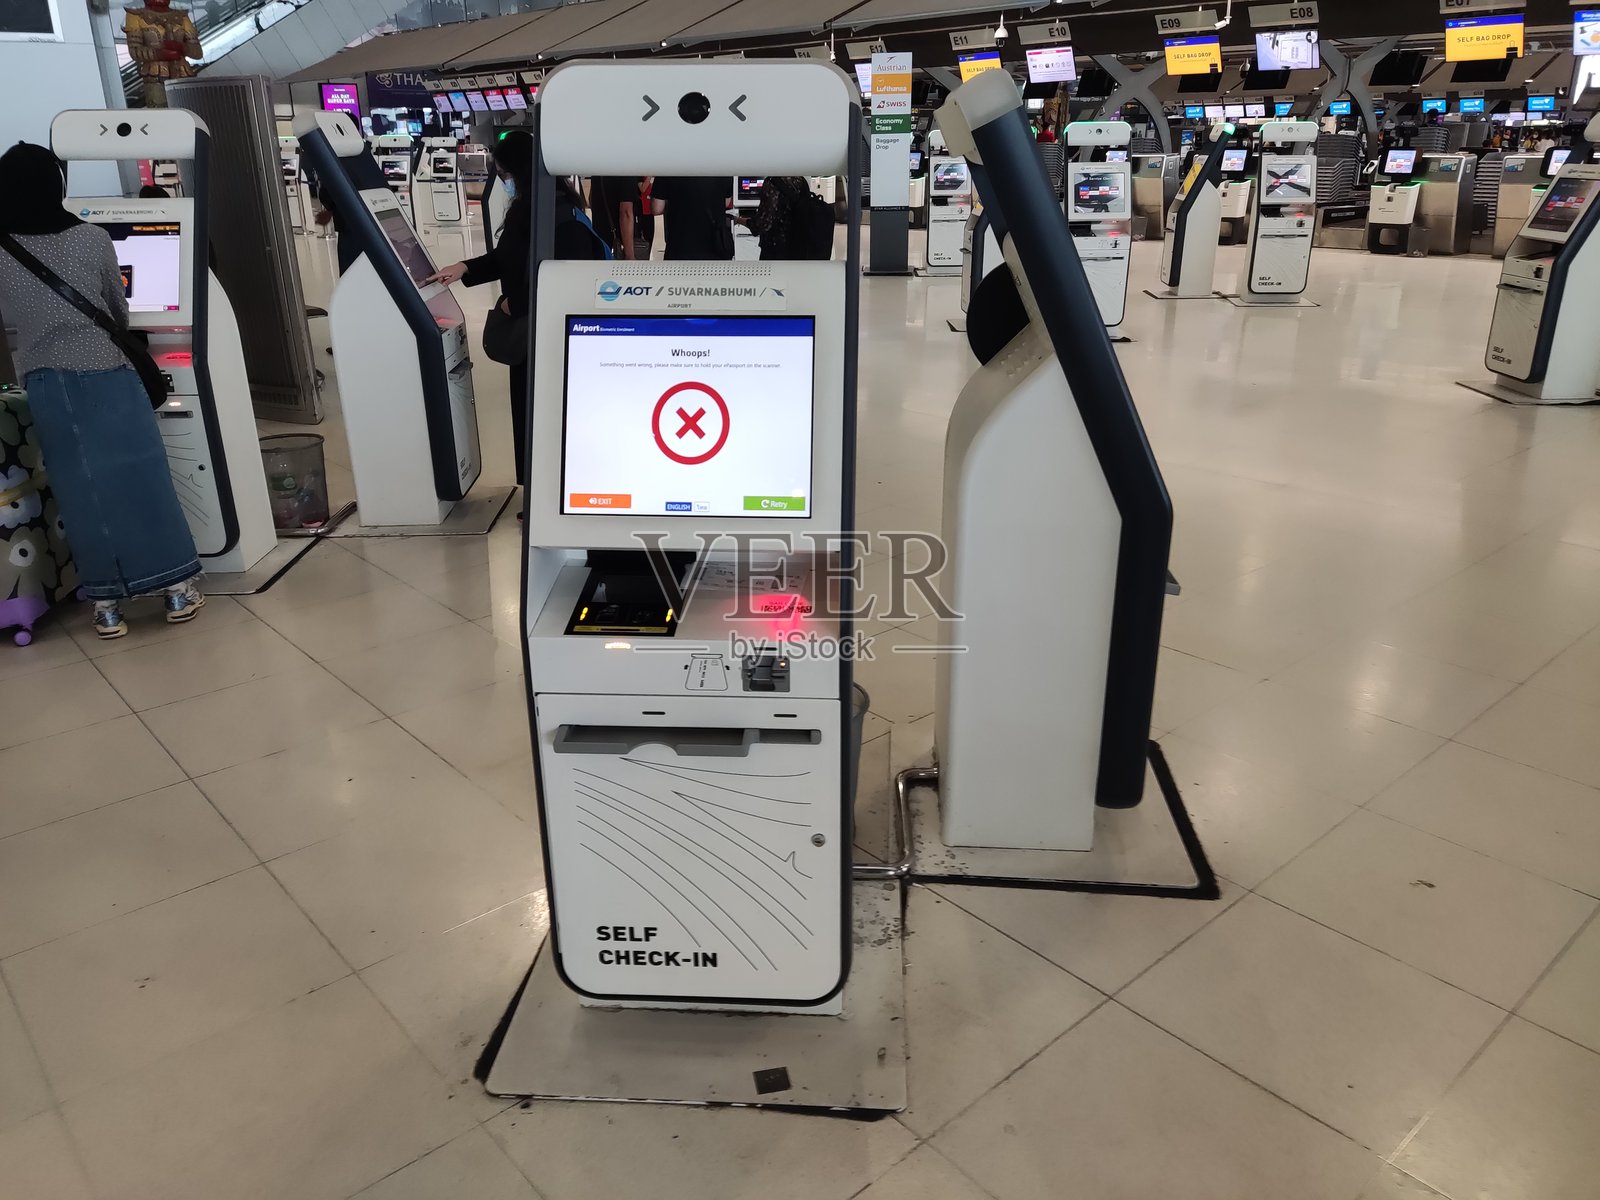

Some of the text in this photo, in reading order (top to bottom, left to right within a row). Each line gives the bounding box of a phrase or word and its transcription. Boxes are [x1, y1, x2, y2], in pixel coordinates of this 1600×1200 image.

[1290, 8, 1314, 19] E08
[1160, 18, 1181, 29] E09
[1048, 27, 1067, 38] E10
[1491, 33, 1512, 41] DROP
[953, 35, 969, 46] E11
[876, 64, 907, 72] Austrian
[394, 73, 426, 86] THA
[875, 117, 903, 125] Economy
[623, 286, 652, 296] AOT
[667, 287, 757, 297] SUVARNABHUMI
[572, 323, 600, 334] Airport
[671, 348, 711, 359] Whoops!
[1493, 346, 1504, 354] SELF
[599, 361, 624, 369] Something
[597, 497, 612, 506] EXIT
[667, 503, 691, 511] ENGLISH
[770, 500, 788, 510] Retry
[596, 925, 658, 942] SELF
[598, 949, 718, 968] CHECK-IN
